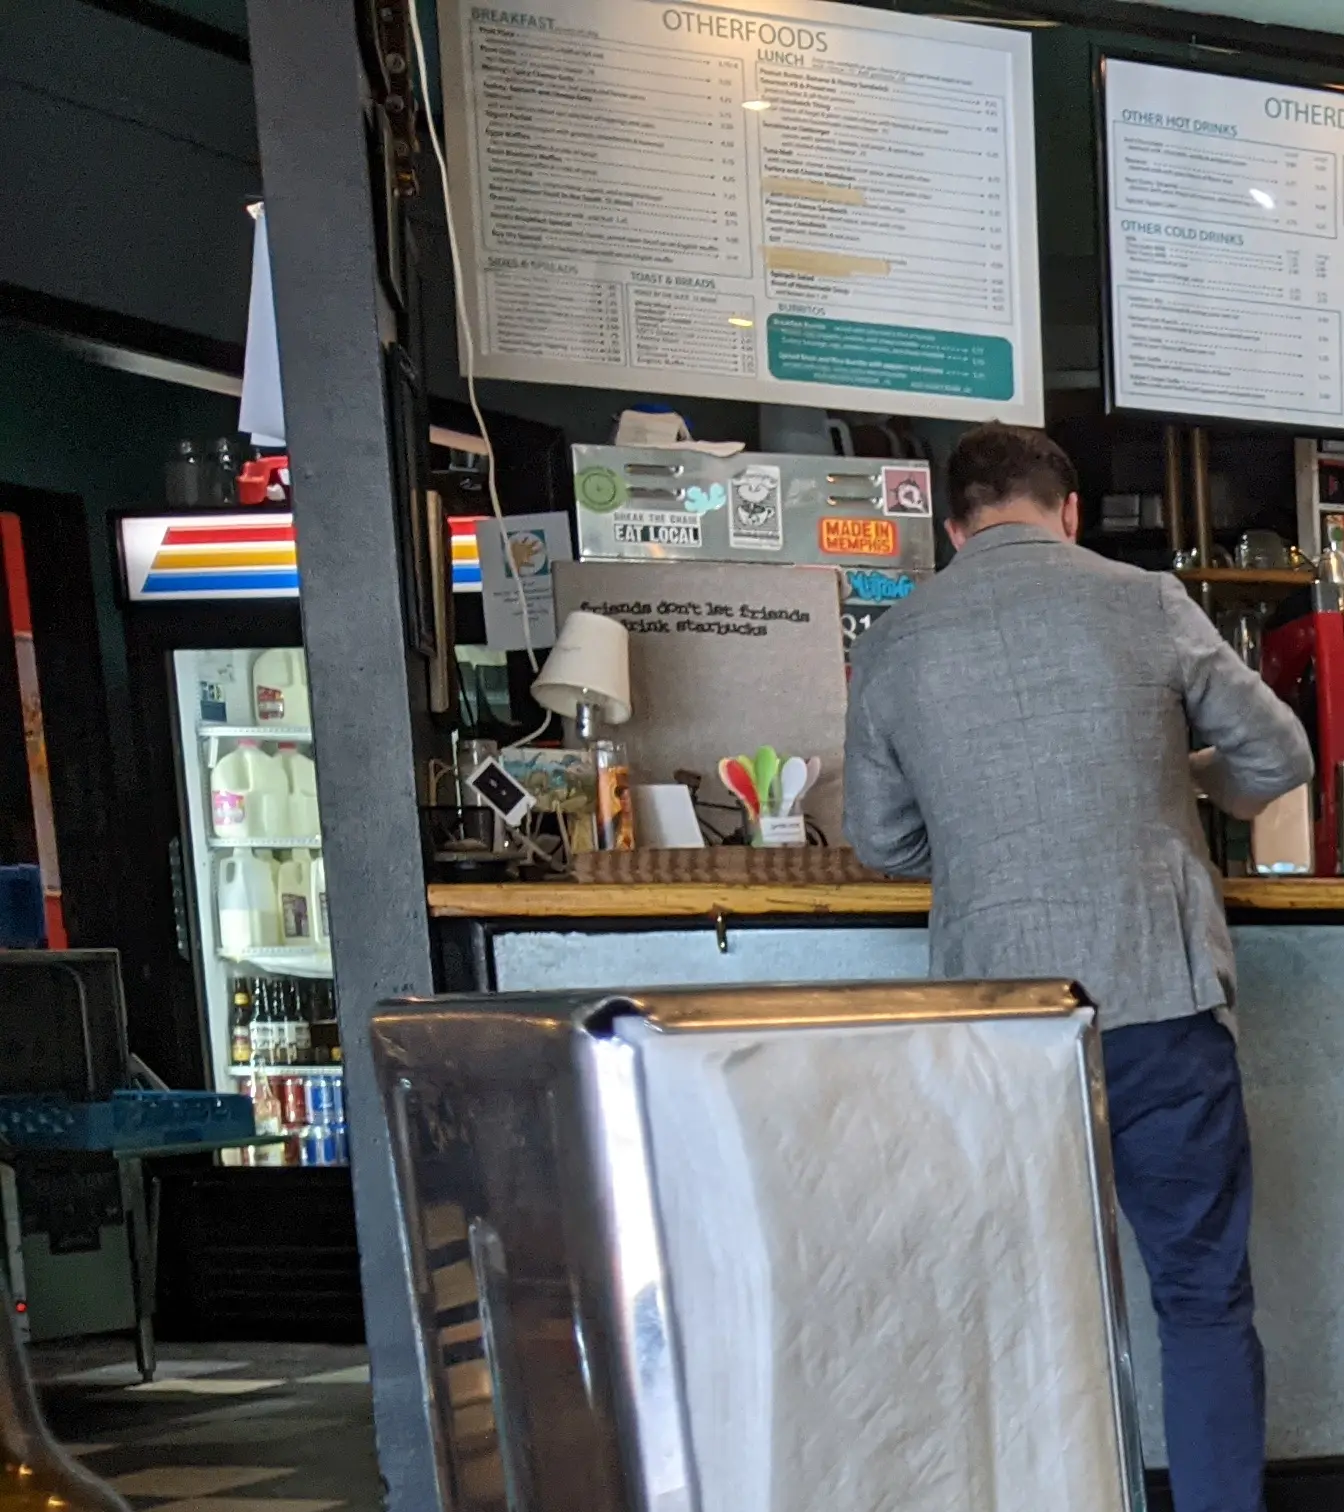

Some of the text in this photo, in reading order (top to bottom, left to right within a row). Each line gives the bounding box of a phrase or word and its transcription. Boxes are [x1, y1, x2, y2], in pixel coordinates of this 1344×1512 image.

[471, 7, 555, 30] BREAKFAST
[662, 9, 828, 53] OTHERFOODS
[757, 48, 804, 67] LUNCH
[1122, 109, 1238, 137] OTHER HOT DRINKS
[1121, 220, 1244, 246] OTHER COLD DRINKS
[615, 525, 698, 545] EAT LOCAL
[826, 520, 889, 539] MADE IN
[826, 536, 891, 552] MEMPHIS
[581, 600, 811, 623] friends don't let friends
[676, 622, 767, 637] starbucks
